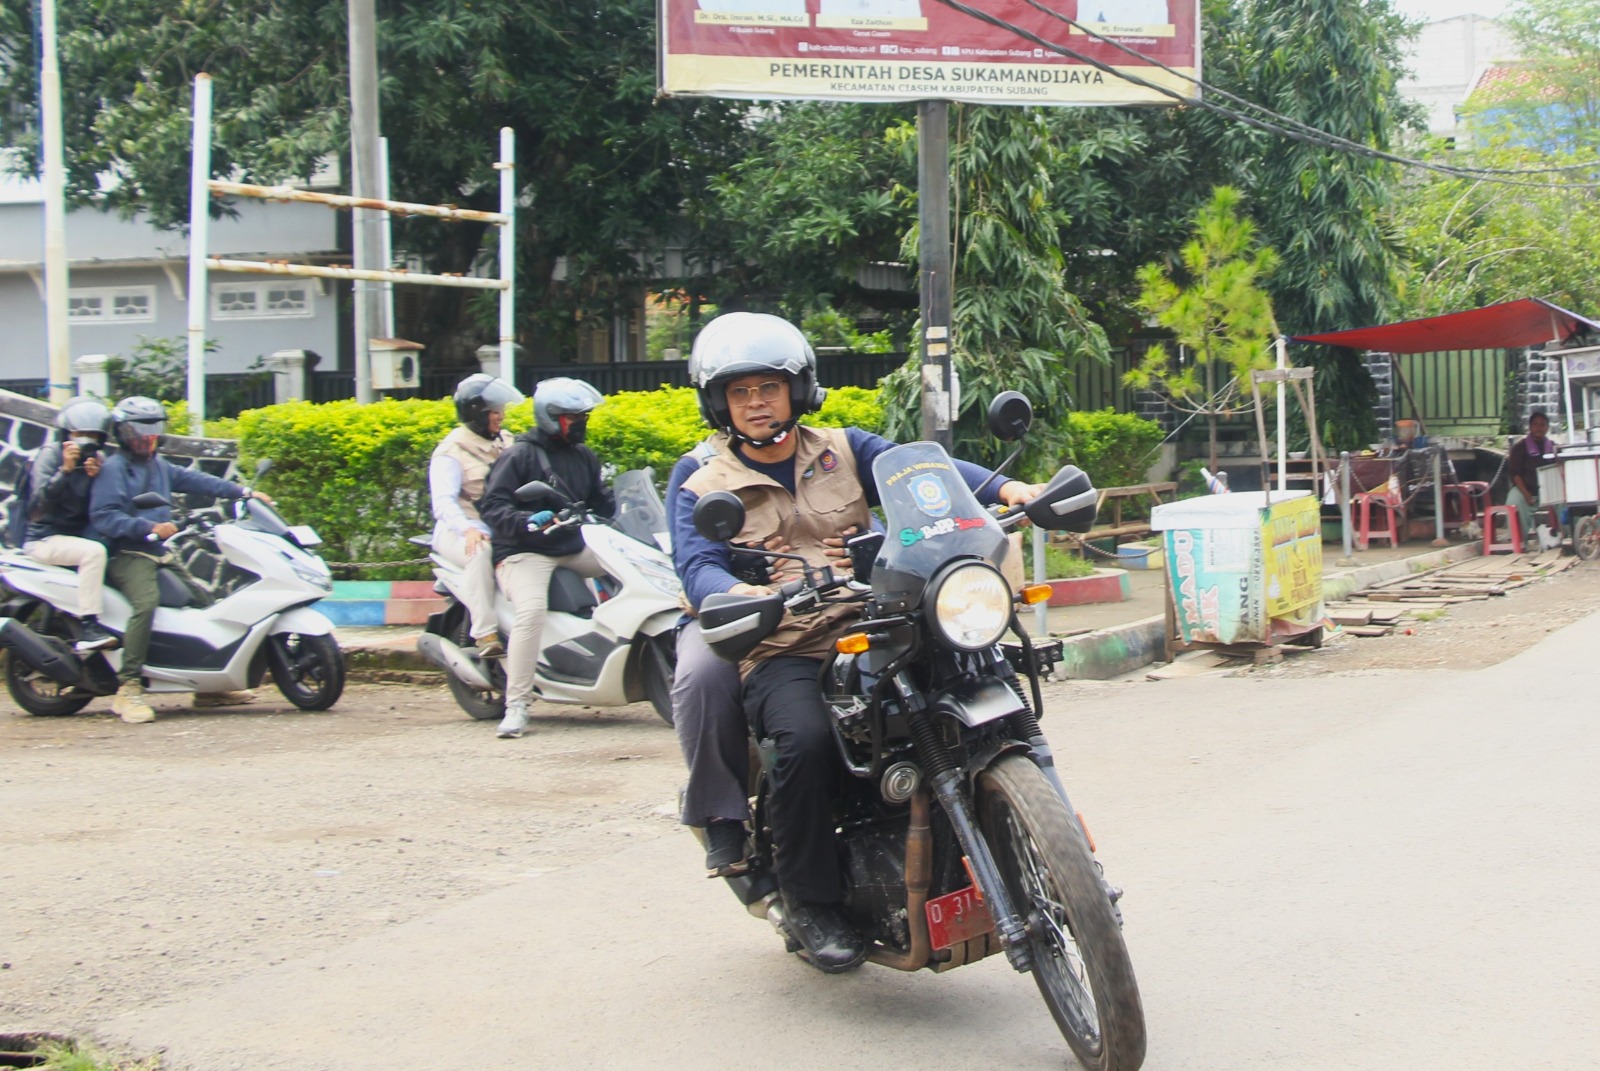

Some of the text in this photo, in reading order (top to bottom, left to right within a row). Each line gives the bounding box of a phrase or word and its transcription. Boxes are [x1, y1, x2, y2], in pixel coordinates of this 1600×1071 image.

[1008, 49, 1031, 58] Subang
[770, 63, 1104, 84] PEMERINTAH DESA SUKAMANDIJAYA
[830, 82, 1048, 95] KECAMATAN CIASEM KABUPATEN SUBANG
[1173, 530, 1200, 625] MADU
